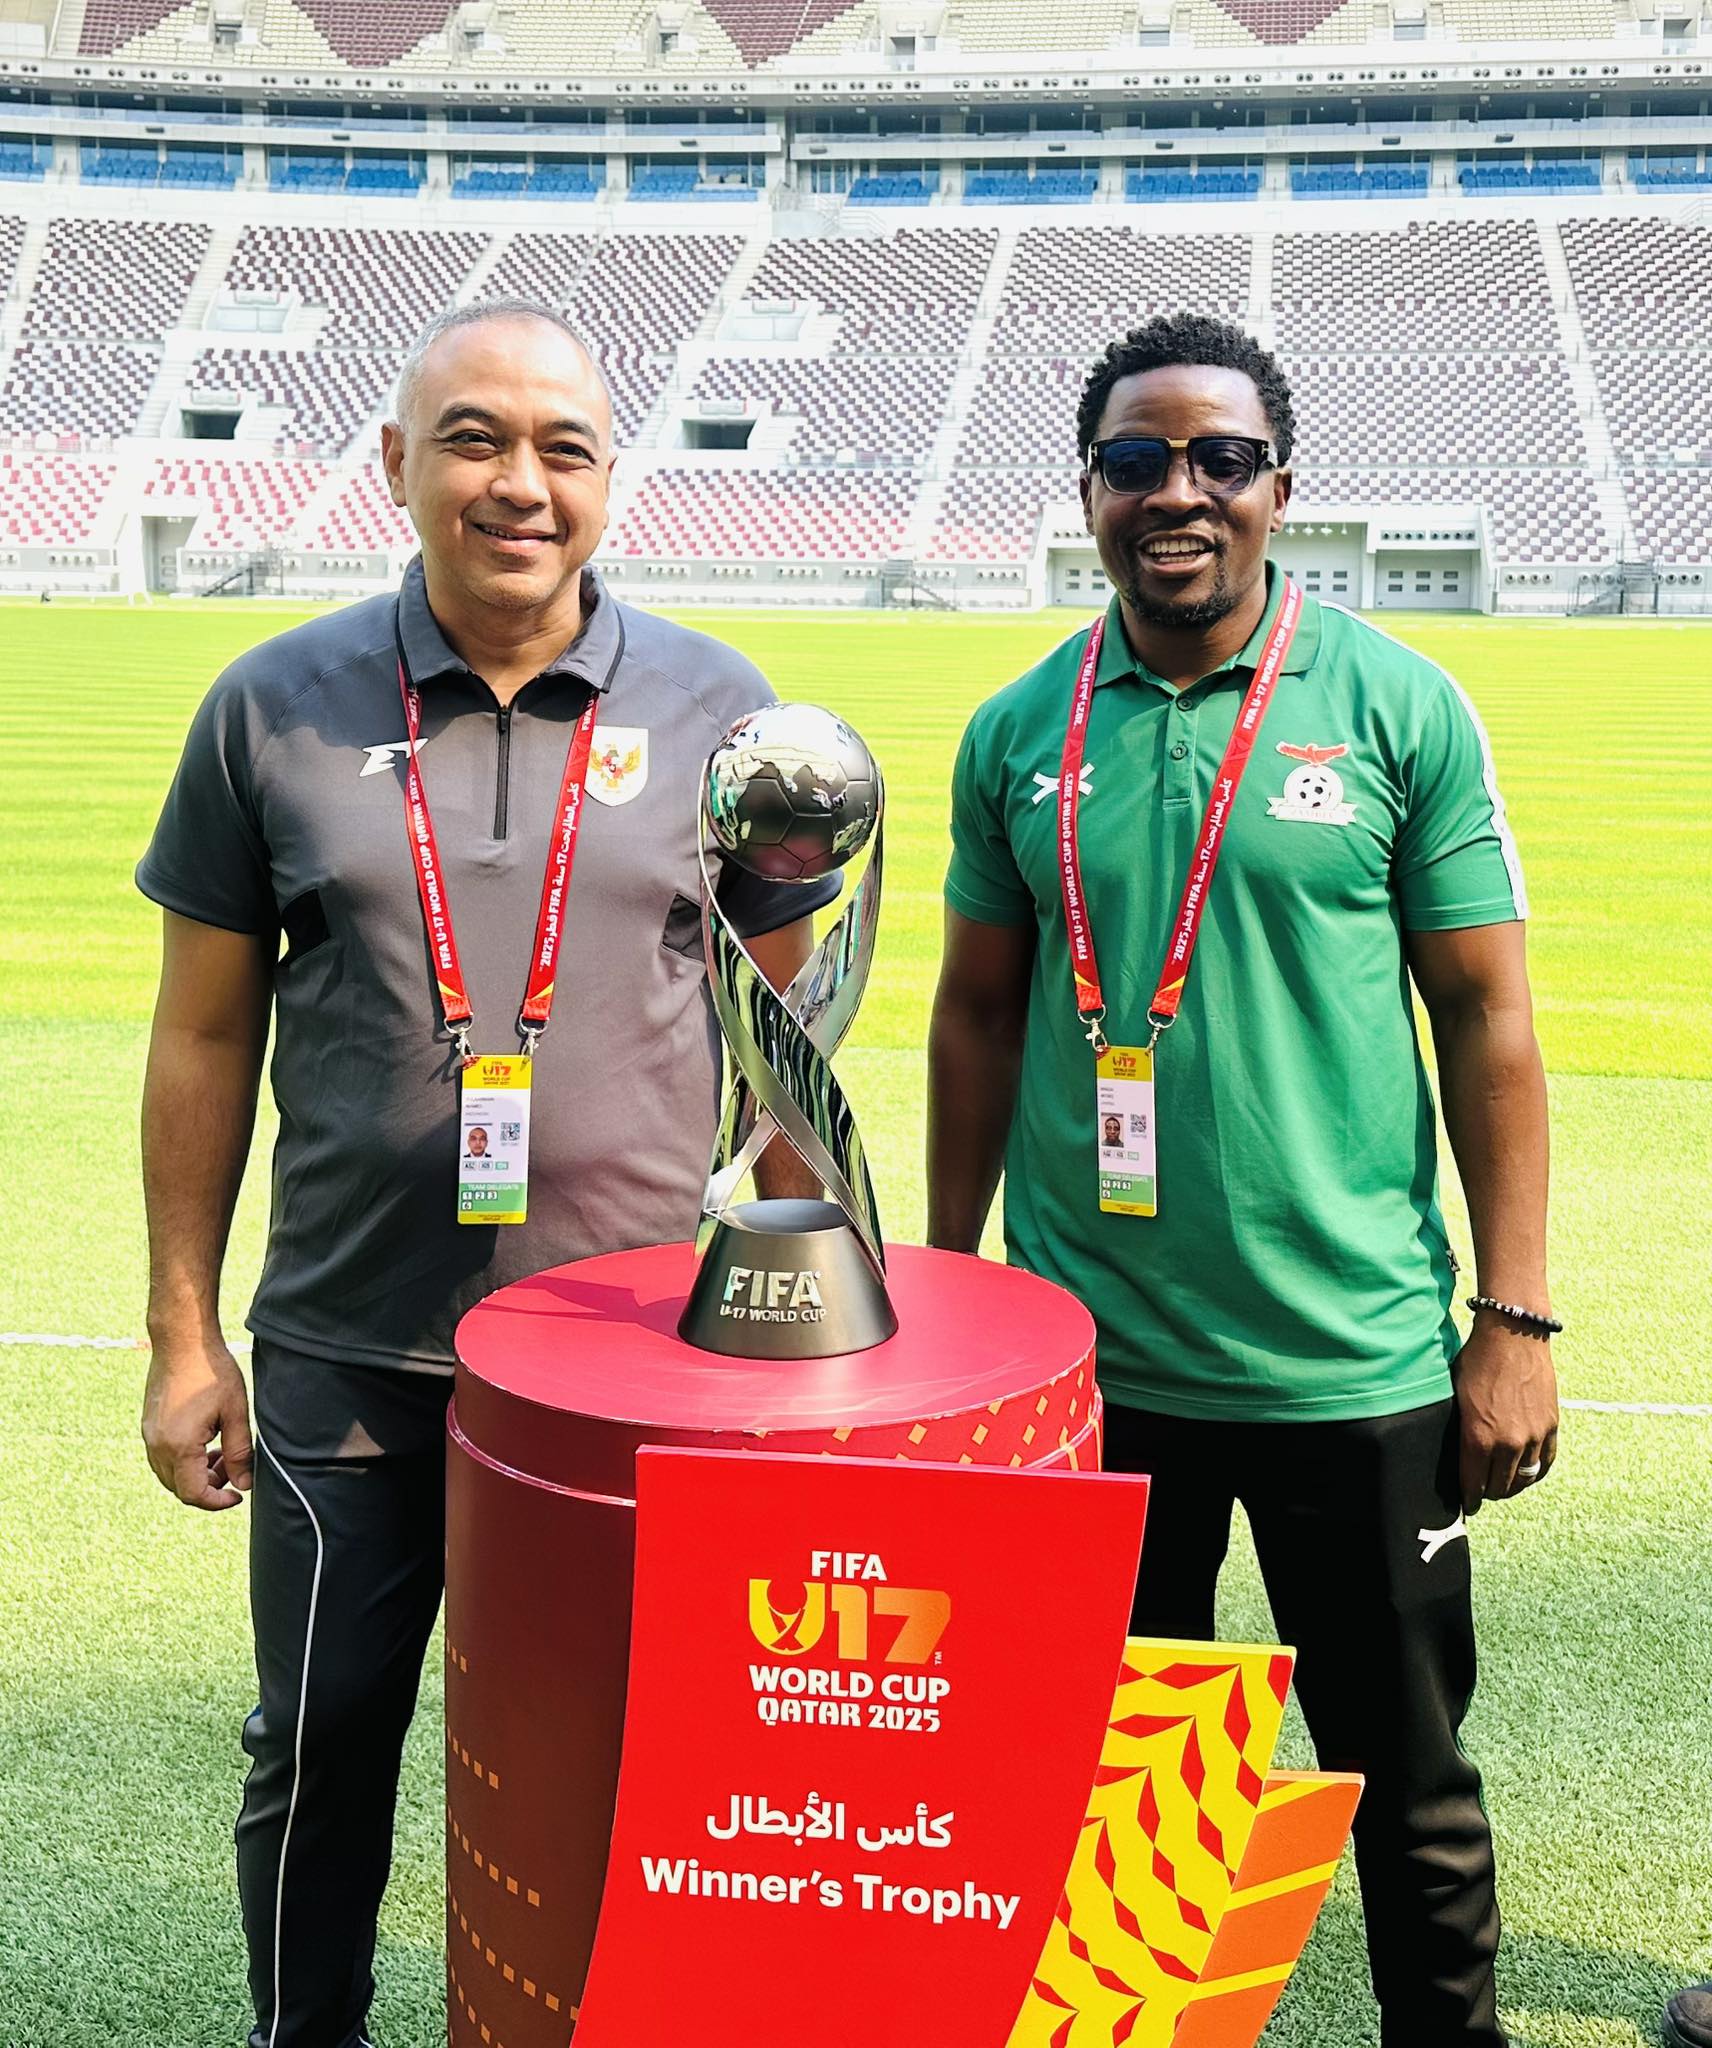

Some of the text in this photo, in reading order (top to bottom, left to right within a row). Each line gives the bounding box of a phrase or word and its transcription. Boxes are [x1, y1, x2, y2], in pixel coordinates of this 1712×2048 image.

[1242, 707, 1259, 730] FIFA
[1251, 684, 1267, 708] U-17
[1260, 648, 1280, 685] WORLD
[1273, 627, 1287, 648] CUP
[420, 844, 433, 869] CUP
[556, 851, 567, 865] 17
[1062, 773, 1088, 961] FIFA U-17 WORLD CUP QATAR 2025
[1200, 848, 1211, 861] 17
[425, 870, 442, 914] WORLD
[549, 887, 562, 914] FIFA
[1187, 884, 1203, 909] FIFA
[433, 916, 447, 942] U-17
[438, 942, 453, 969] FIFA
[540, 937, 554, 967] 2025
[1173, 931, 1189, 961] 2025
[723, 1266, 823, 1308] FIFA
[720, 1304, 827, 1322] U-17 WORLD CUP
[811, 1550, 887, 1581] FIFA
[749, 1664, 950, 1703] WORLD CUP
[757, 1697, 941, 1733] QATAR 2025
[706, 1791, 954, 1852] كأس الأبطال
[640, 1856, 1020, 1930] Winner's Trophy
